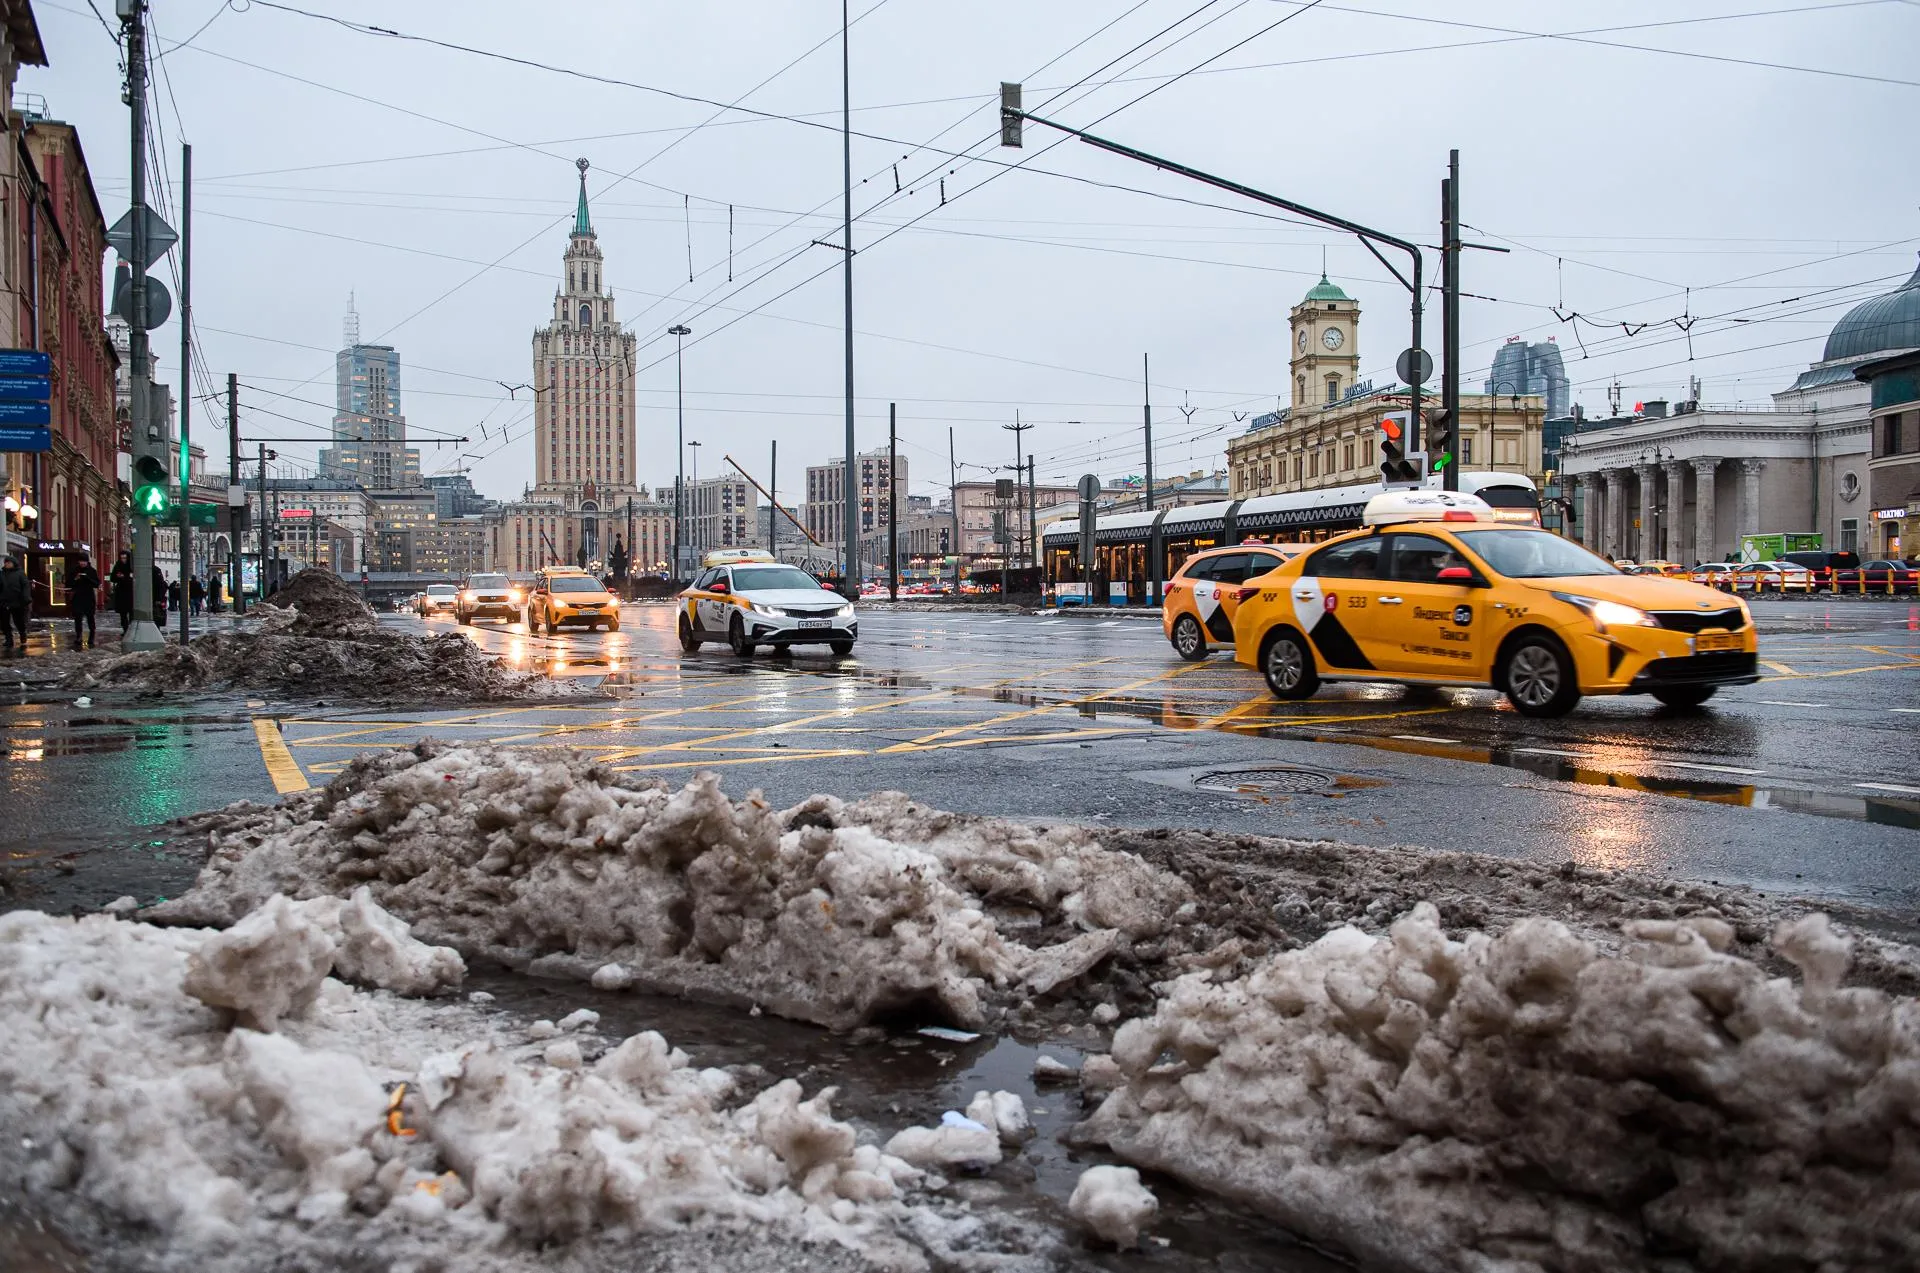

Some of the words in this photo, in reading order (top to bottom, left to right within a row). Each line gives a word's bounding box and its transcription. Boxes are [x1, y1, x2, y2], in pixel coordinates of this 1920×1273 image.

[1343, 379, 1373, 399] ВОКЗАЛ
[1413, 605, 1452, 621] Яндекс
[1438, 626, 1471, 642] Такси
